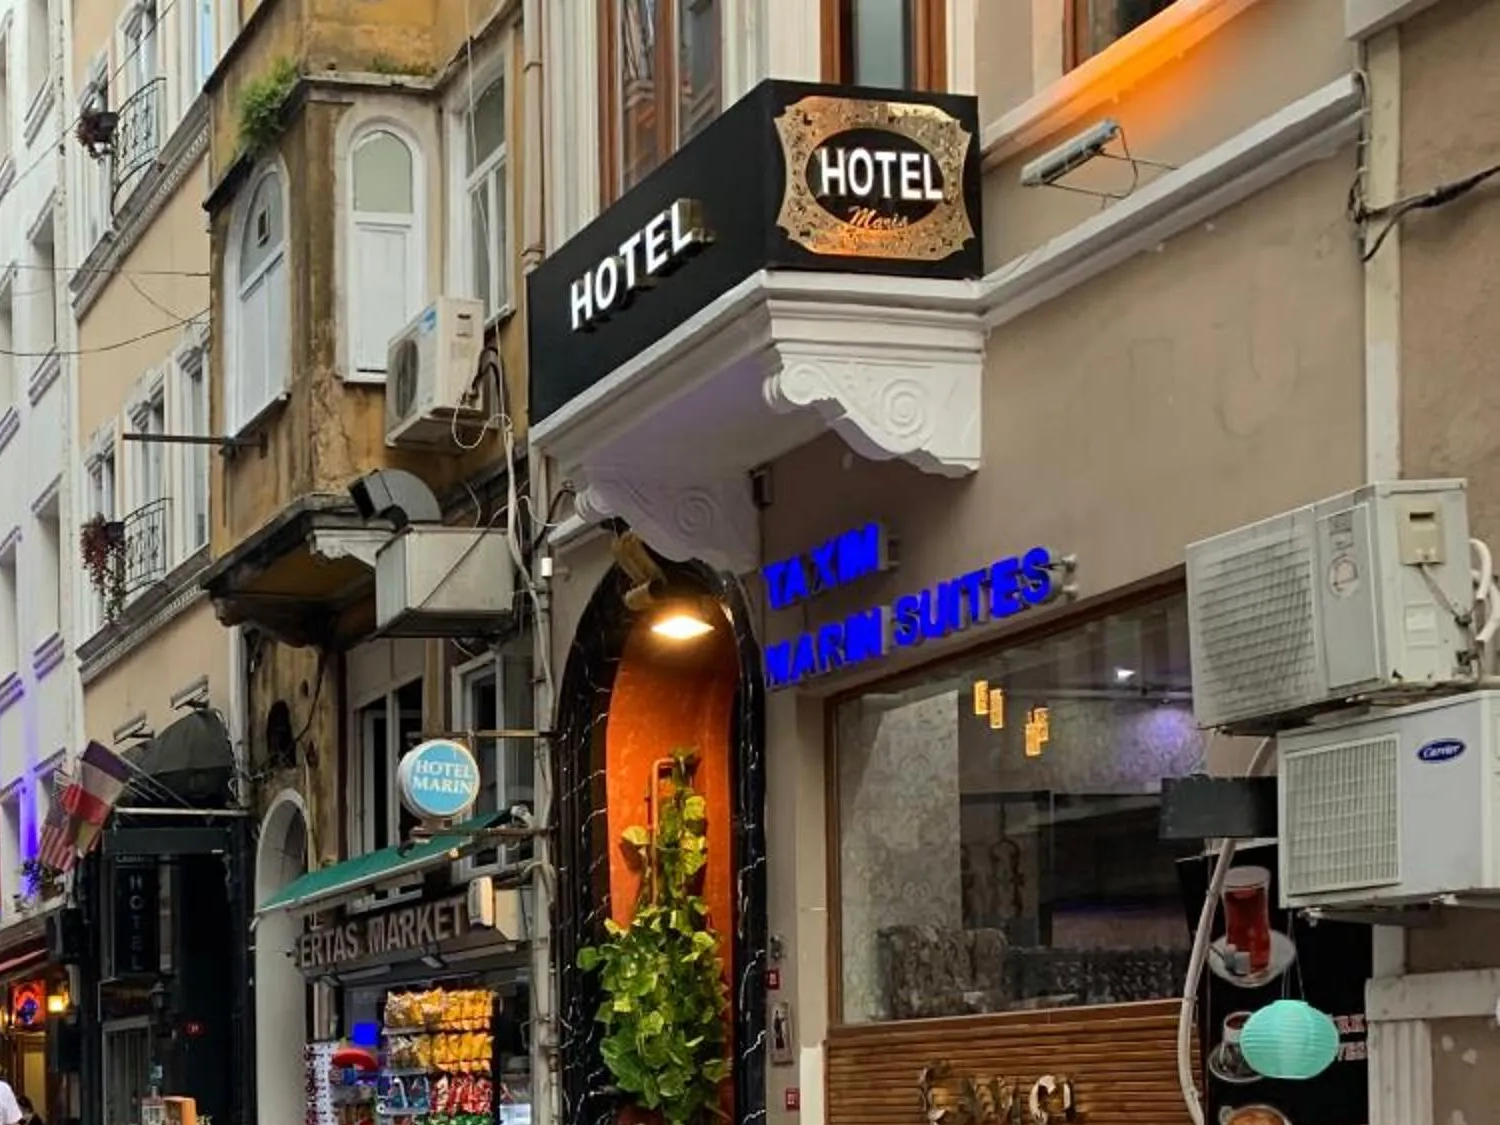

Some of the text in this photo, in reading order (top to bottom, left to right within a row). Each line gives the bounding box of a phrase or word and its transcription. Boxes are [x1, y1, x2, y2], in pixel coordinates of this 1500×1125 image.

[820, 147, 944, 200] HOTEL
[571, 199, 694, 331] HOTEL
[894, 547, 1053, 646] SUITES
[412, 777, 474, 796] MARIN
[417, 759, 474, 780] HOTEL
[129, 873, 144, 972] HOTEL
[368, 893, 467, 954] MARKET
